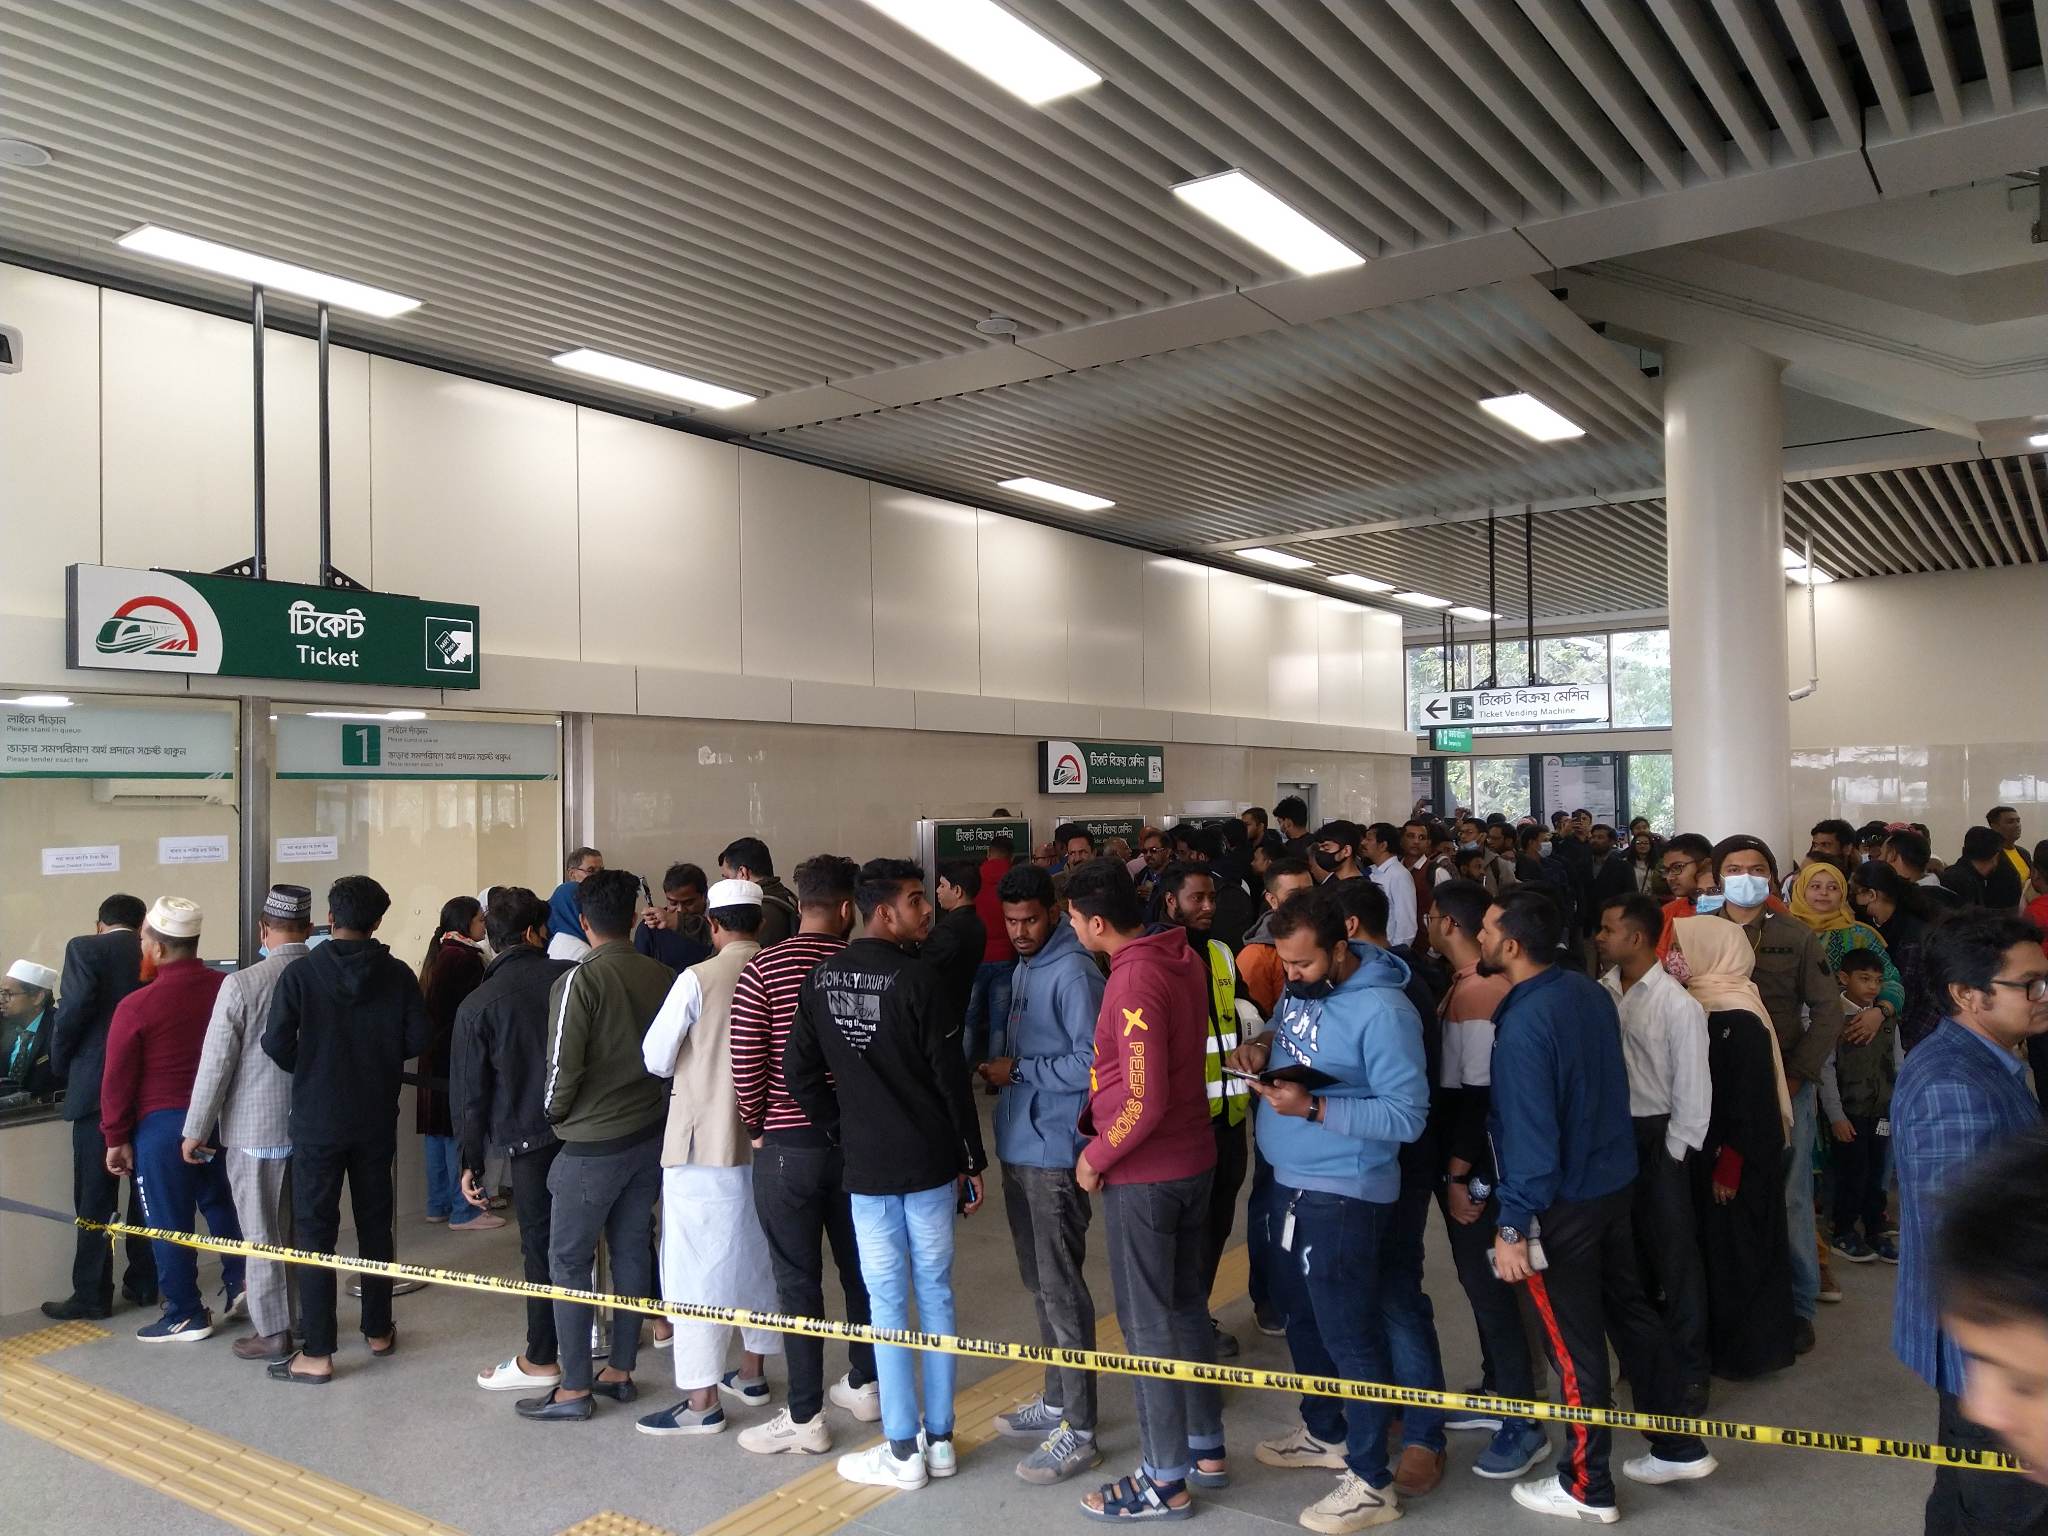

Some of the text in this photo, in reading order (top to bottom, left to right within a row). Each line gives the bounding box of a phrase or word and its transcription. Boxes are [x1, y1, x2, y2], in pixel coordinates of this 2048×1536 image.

[288, 600, 366, 639] টিকেট
[440, 636, 451, 649] MRT
[296, 644, 360, 667] Ticket
[1478, 687, 1589, 706] টিকেট বিক্রয় মেশিন
[1479, 707, 1576, 718] Ticket Vending Machine
[356, 728, 368, 763] 1
[1092, 776, 1145, 787] Ticket Vending Machine
[1106, 1041, 1145, 1148] PEEP SHOW
[1018, 1345, 1053, 1361] NOT
[1062, 1350, 1086, 1364] DO
[1095, 1354, 1175, 1375] CAUTION
[1193, 1365, 1253, 1384] ENTER
[1264, 1373, 1304, 1390] NOT
[1782, 1430, 1862, 1452] ENTER
[1877, 1440, 1931, 1459] NOT
[1946, 1447, 1982, 1463] DO
